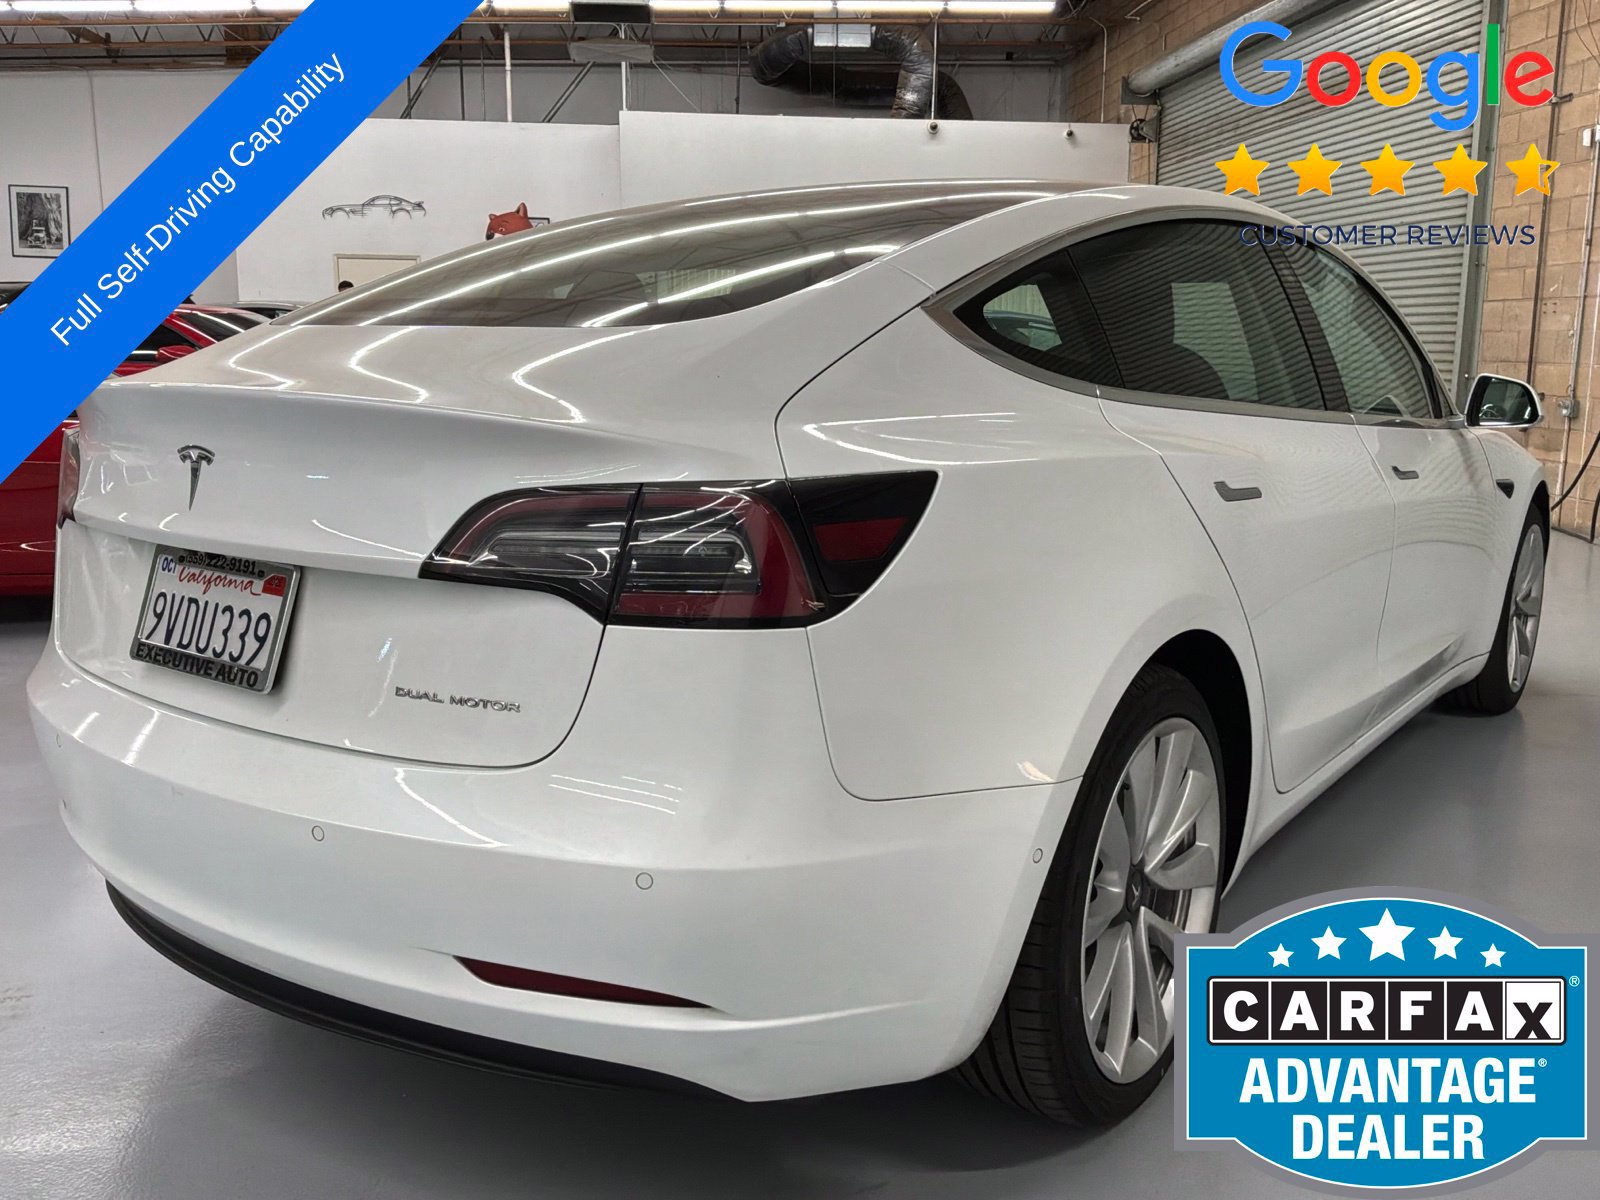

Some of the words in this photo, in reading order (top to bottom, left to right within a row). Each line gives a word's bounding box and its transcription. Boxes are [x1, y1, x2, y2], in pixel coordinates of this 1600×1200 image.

[178, 566, 262, 596] California
[146, 591, 272, 666] 9VDU339
[135, 642, 214, 677] EXECUTIVE
[216, 664, 259, 688] AUTO
[395, 686, 445, 704] DUAL
[449, 695, 522, 713] MOTOR
